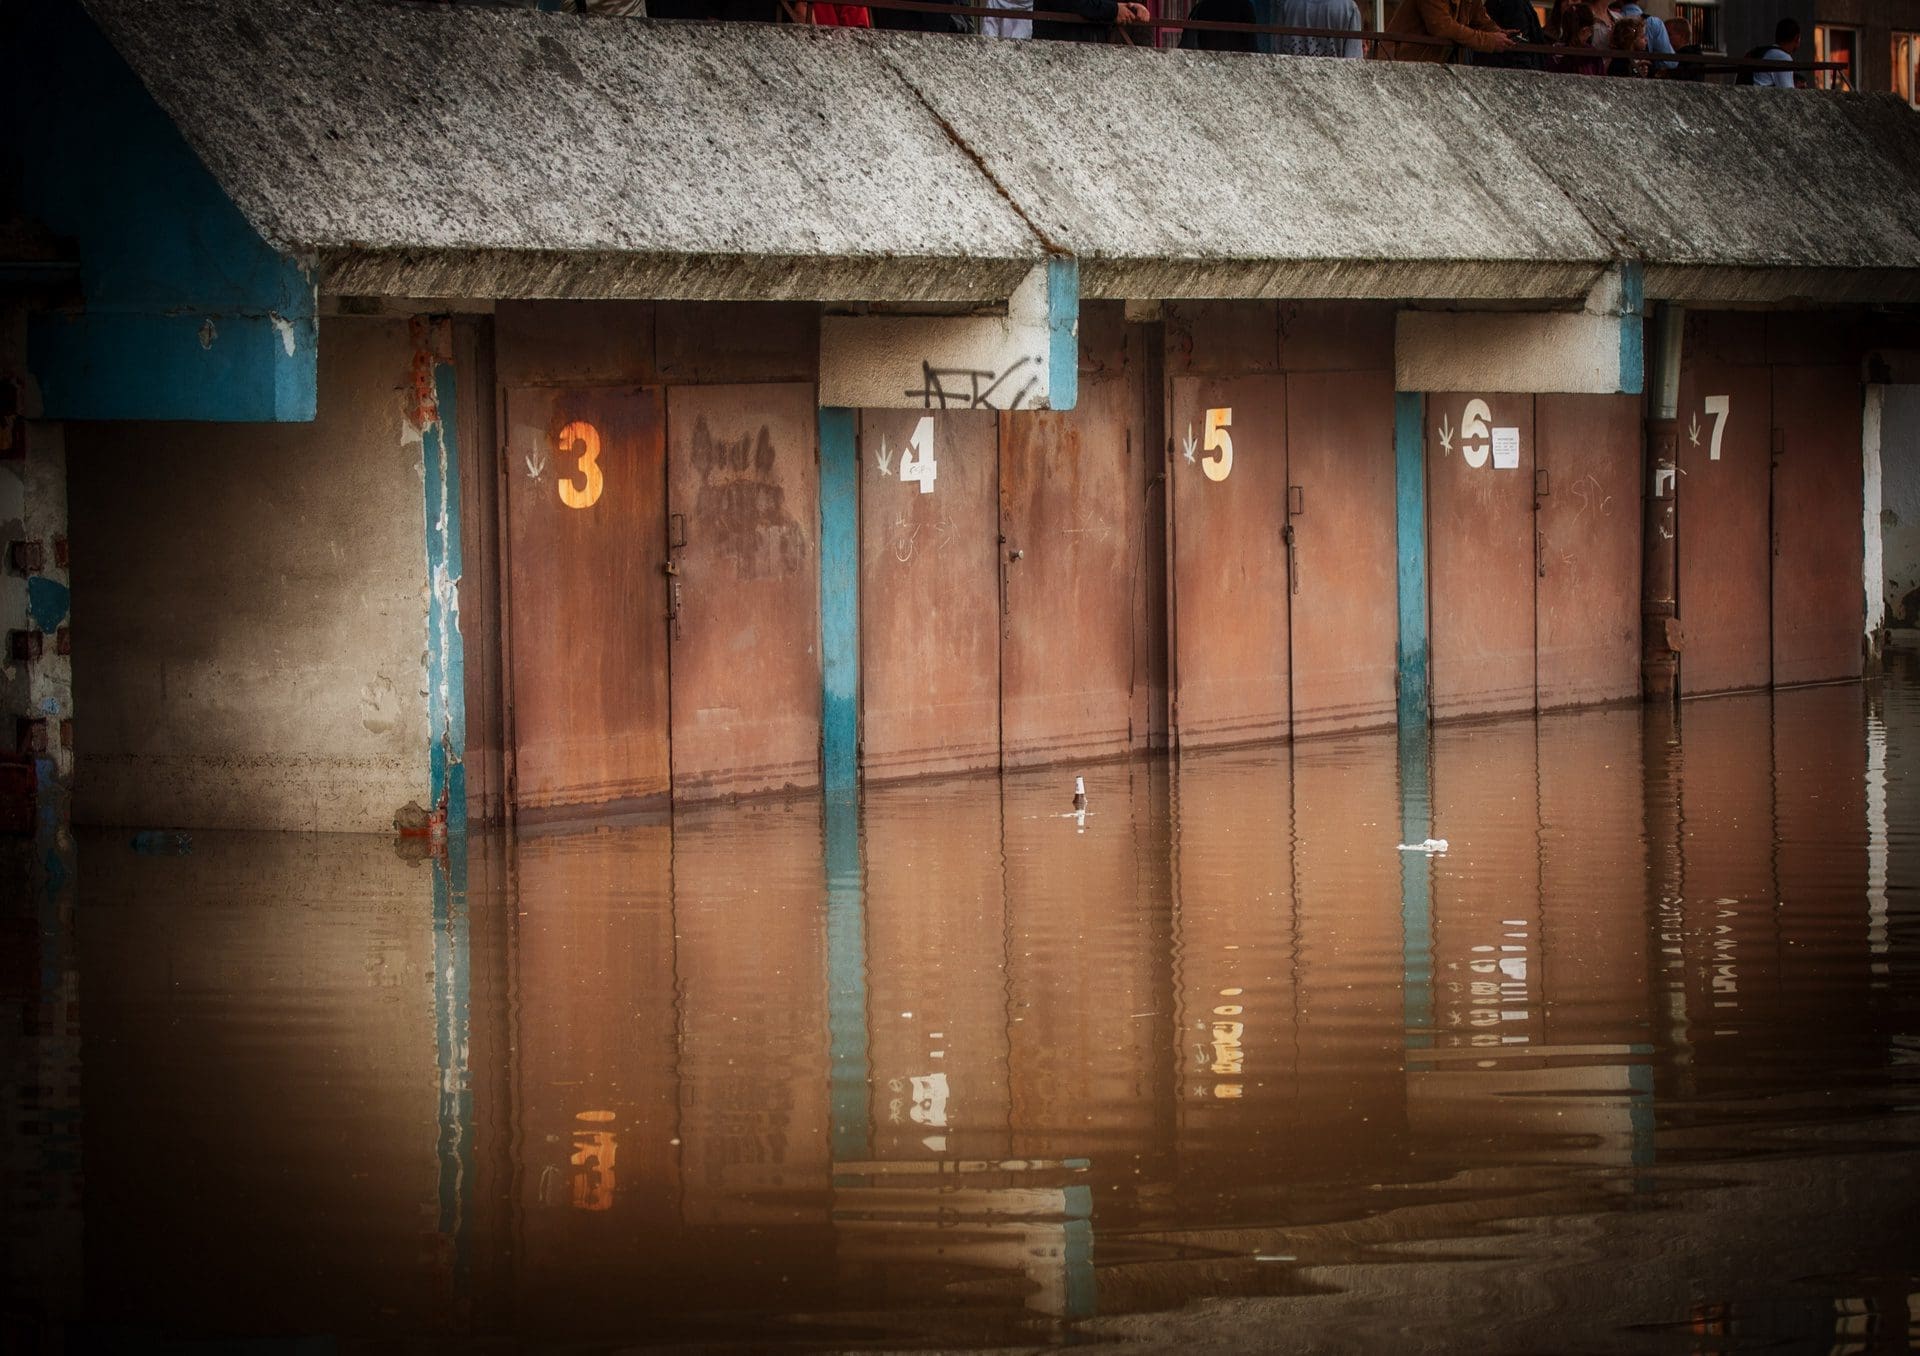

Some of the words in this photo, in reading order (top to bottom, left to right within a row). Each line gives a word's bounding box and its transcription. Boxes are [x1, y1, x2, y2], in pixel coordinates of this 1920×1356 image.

[900, 416, 937, 494] 4
[1202, 407, 1234, 482] 5
[1461, 398, 1492, 469] 6
[1705, 395, 1730, 460] 7
[558, 421, 604, 510] 3
